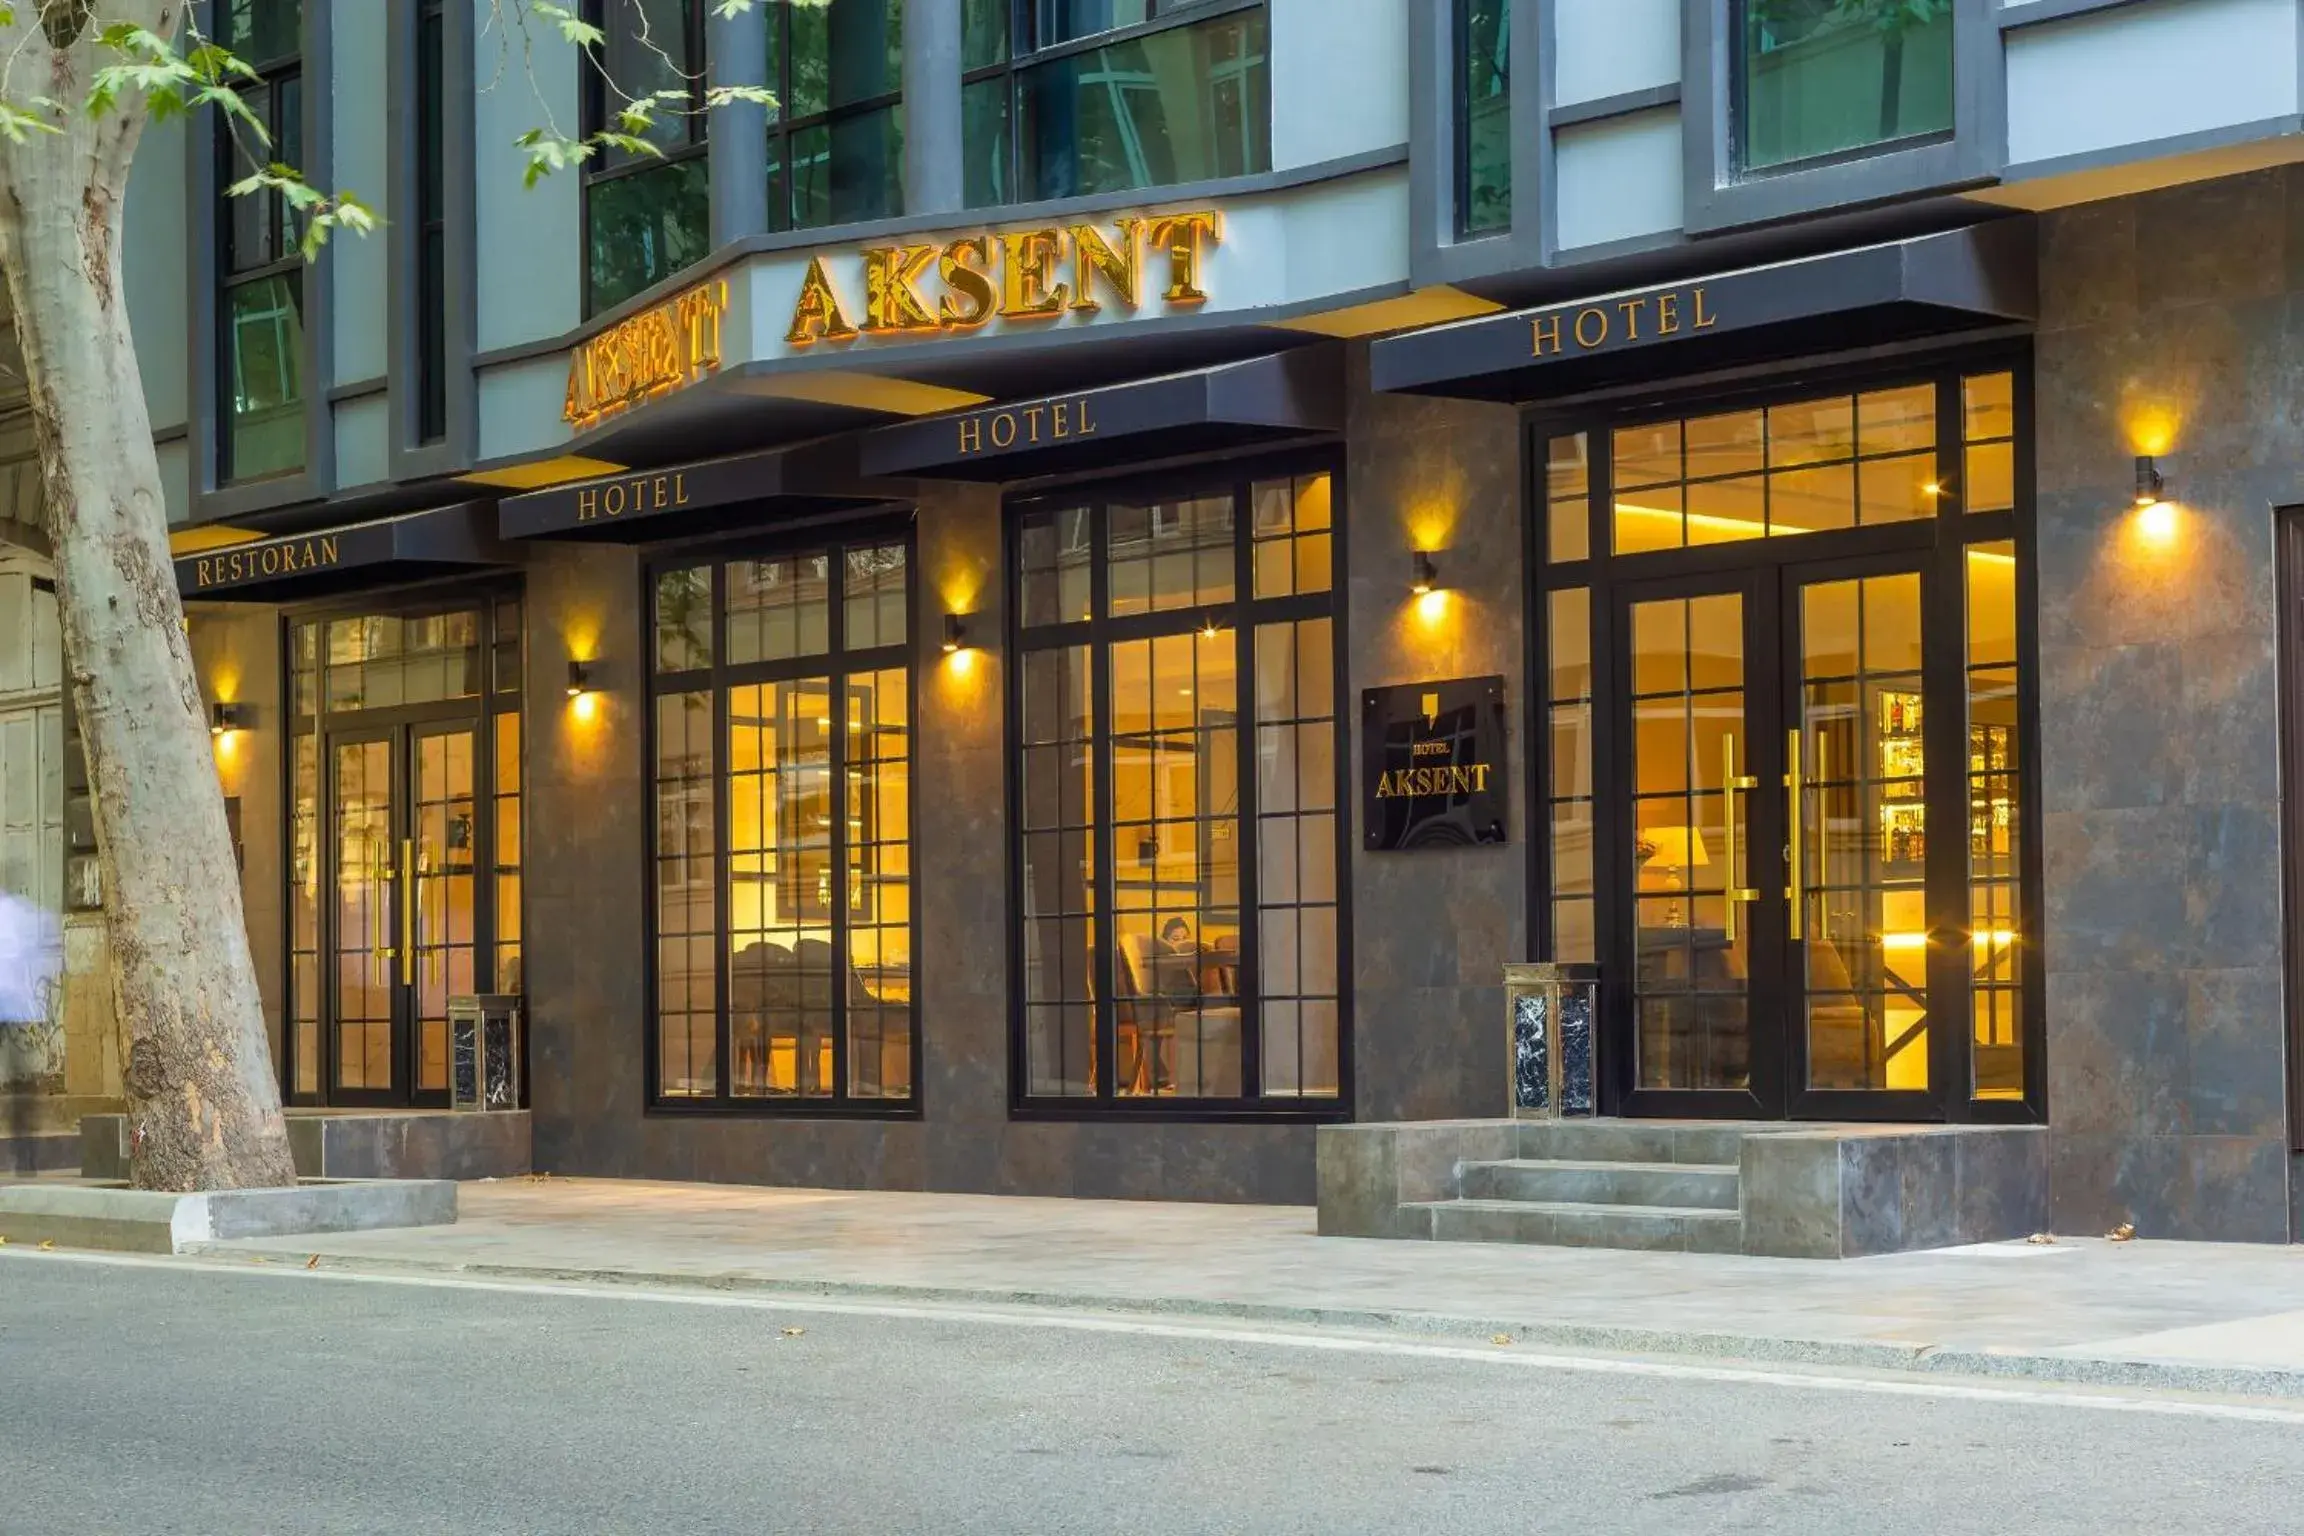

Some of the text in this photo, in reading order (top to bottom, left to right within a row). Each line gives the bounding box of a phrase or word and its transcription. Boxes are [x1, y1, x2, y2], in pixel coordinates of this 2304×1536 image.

[784, 210, 1224, 345] AKSENT
[1531, 288, 1717, 357] HOTEL
[959, 400, 1097, 453] HOTEL
[578, 473, 689, 521] HOTEL
[197, 536, 339, 587] RESTORAN
[1412, 742, 1450, 756] HOTEL
[1375, 764, 1491, 798] AKSENT
